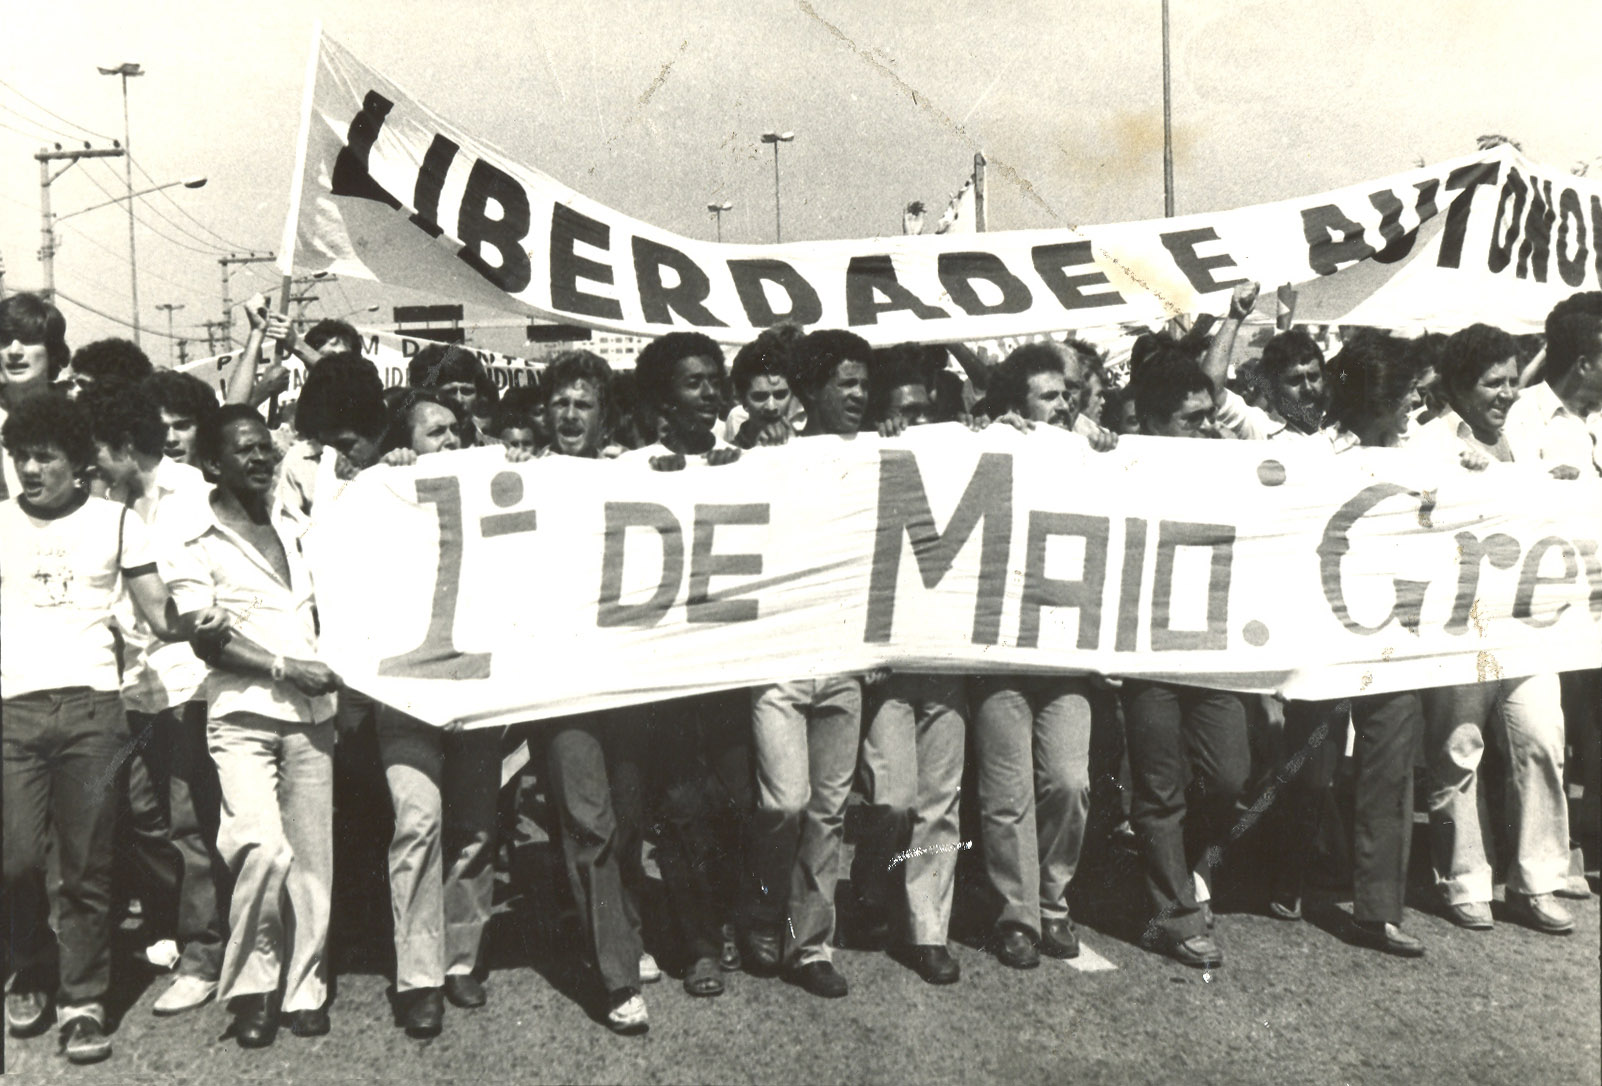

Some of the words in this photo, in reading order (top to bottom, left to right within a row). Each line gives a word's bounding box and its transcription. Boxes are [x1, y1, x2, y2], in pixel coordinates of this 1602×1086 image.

[331, 89, 1128, 328] LIBERDADE
[1160, 226, 1248, 295] E
[596, 501, 771, 629] DE
